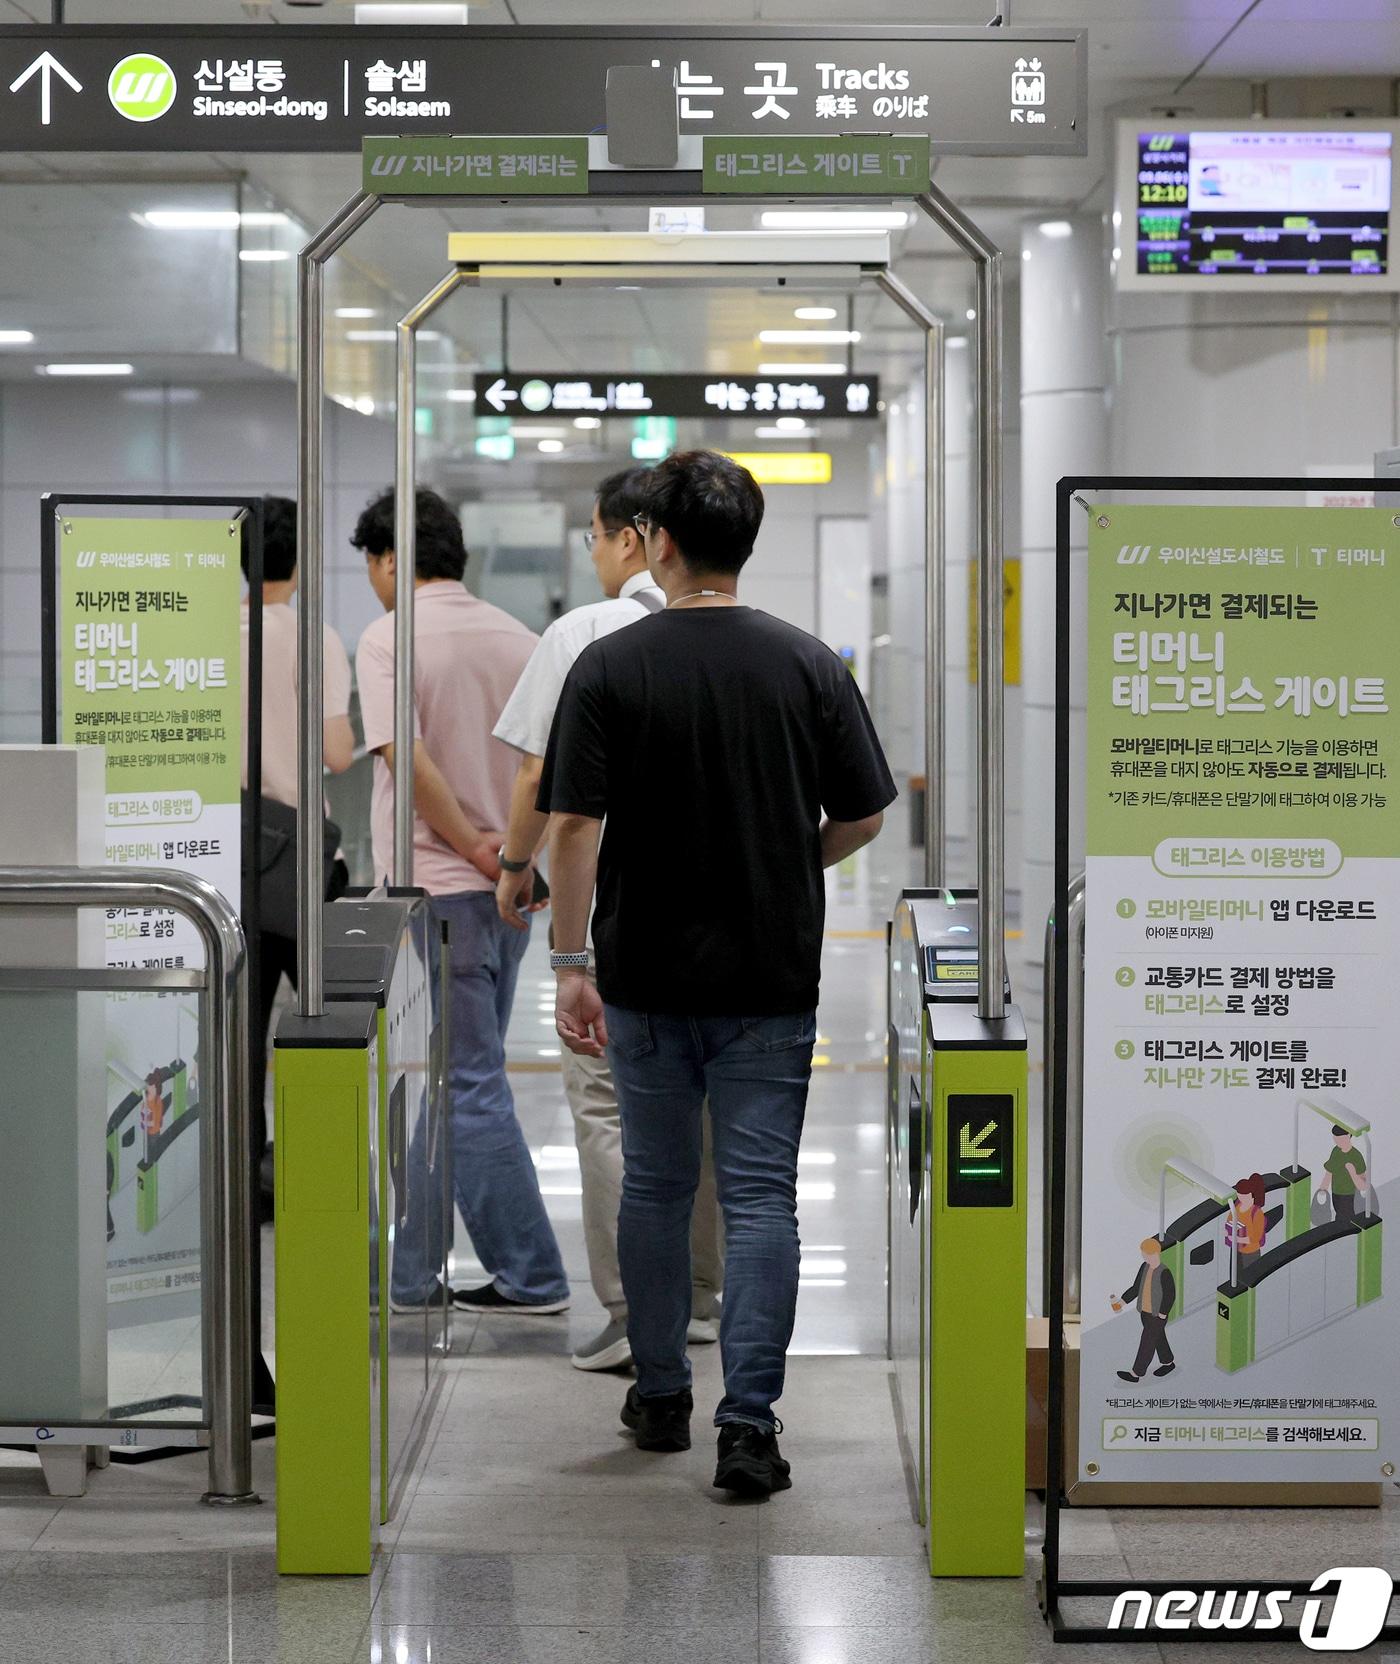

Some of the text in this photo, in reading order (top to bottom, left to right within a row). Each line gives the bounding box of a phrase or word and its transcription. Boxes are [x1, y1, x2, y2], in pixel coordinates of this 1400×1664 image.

[193, 59, 426, 92] 신설동 솔샘
[816, 63, 909, 90] Tracks
[744, 62, 798, 120] 곳
[193, 97, 451, 121] Sinseol-dong Solsaem
[873, 95, 929, 118] のりば
[411, 155, 578, 177] 지나가면 결제되는
[715, 153, 882, 177] 태그리스 게이트
[1140, 185, 1187, 202] 12:10
[198, 553, 225, 567] 티머니
[1158, 547, 1285, 565] 우이신설도시철도
[1337, 548, 1385, 566] 티머니
[75, 591, 189, 612] 지나가면 결제되는
[1114, 593, 1318, 619] 지나가면 결제되는
[74, 622, 138, 657] 티머니
[1113, 631, 1224, 672] 티머니
[74, 657, 228, 693] 태그리스 게이트
[1112, 675, 1389, 717] 태그리스 게이트
[75, 709, 221, 725] 모바일티머니로 태그리스 기능을 이용하면
[75, 731, 106, 745] 휴대폰을
[107, 731, 123, 744] 대지
[125, 730, 149, 744] 않아도
[150, 728, 183, 743] 자동으로
[1110, 738, 1378, 756] 모바일티머니로 태그리스 기능을 이용하면
[1110, 761, 1387, 779] 휴대폰을 대지 않아도 자동으로 결제됩니다.
[108, 799, 192, 817] 태그리스 이용방법
[1142, 791, 1223, 807] 카드/휴대폰은
[1226, 792, 1276, 807] 단말기에
[1280, 792, 1330, 807] 태그하여
[1333, 792, 1358, 807] 이용
[1360, 792, 1387, 808] 가능
[163, 842, 174, 859] 앱
[177, 840, 221, 859] 다운로드
[1171, 847, 1325, 868] 태그리스 이용방법
[1145, 899, 1264, 921] 모바일티머니
[1270, 900, 1289, 921] 앱
[1296, 900, 1377, 921] 다운로드
[154, 920, 174, 938] 설정
[1145, 927, 1213, 939] (아이폰 미지원)
[1145, 967, 1224, 988] 교통카드
[1230, 967, 1268, 989] 결제
[1275, 967, 1335, 989] 방법을
[1145, 994, 1289, 1016] 태그리스로 설정
[1145, 1040, 1224, 1061] 태그리스
[1230, 1040, 1308, 1062] 게이트를
[1144, 1067, 1347, 1089] 지나만 가도 결제 완료!
[1144, 1398, 1178, 1409] 게이트가
[1180, 1398, 1197, 1409] 없는
[1198, 1398, 1232, 1409] 역에서는
[1233, 1398, 1288, 1409] 카드/휴대폰을
[1289, 1398, 1323, 1409] 단말기에
[1324, 1398, 1377, 1409] 태그해주세요.
[1134, 1427, 1366, 1442] 지금 티머니 태그리스를 검색해보세요.
